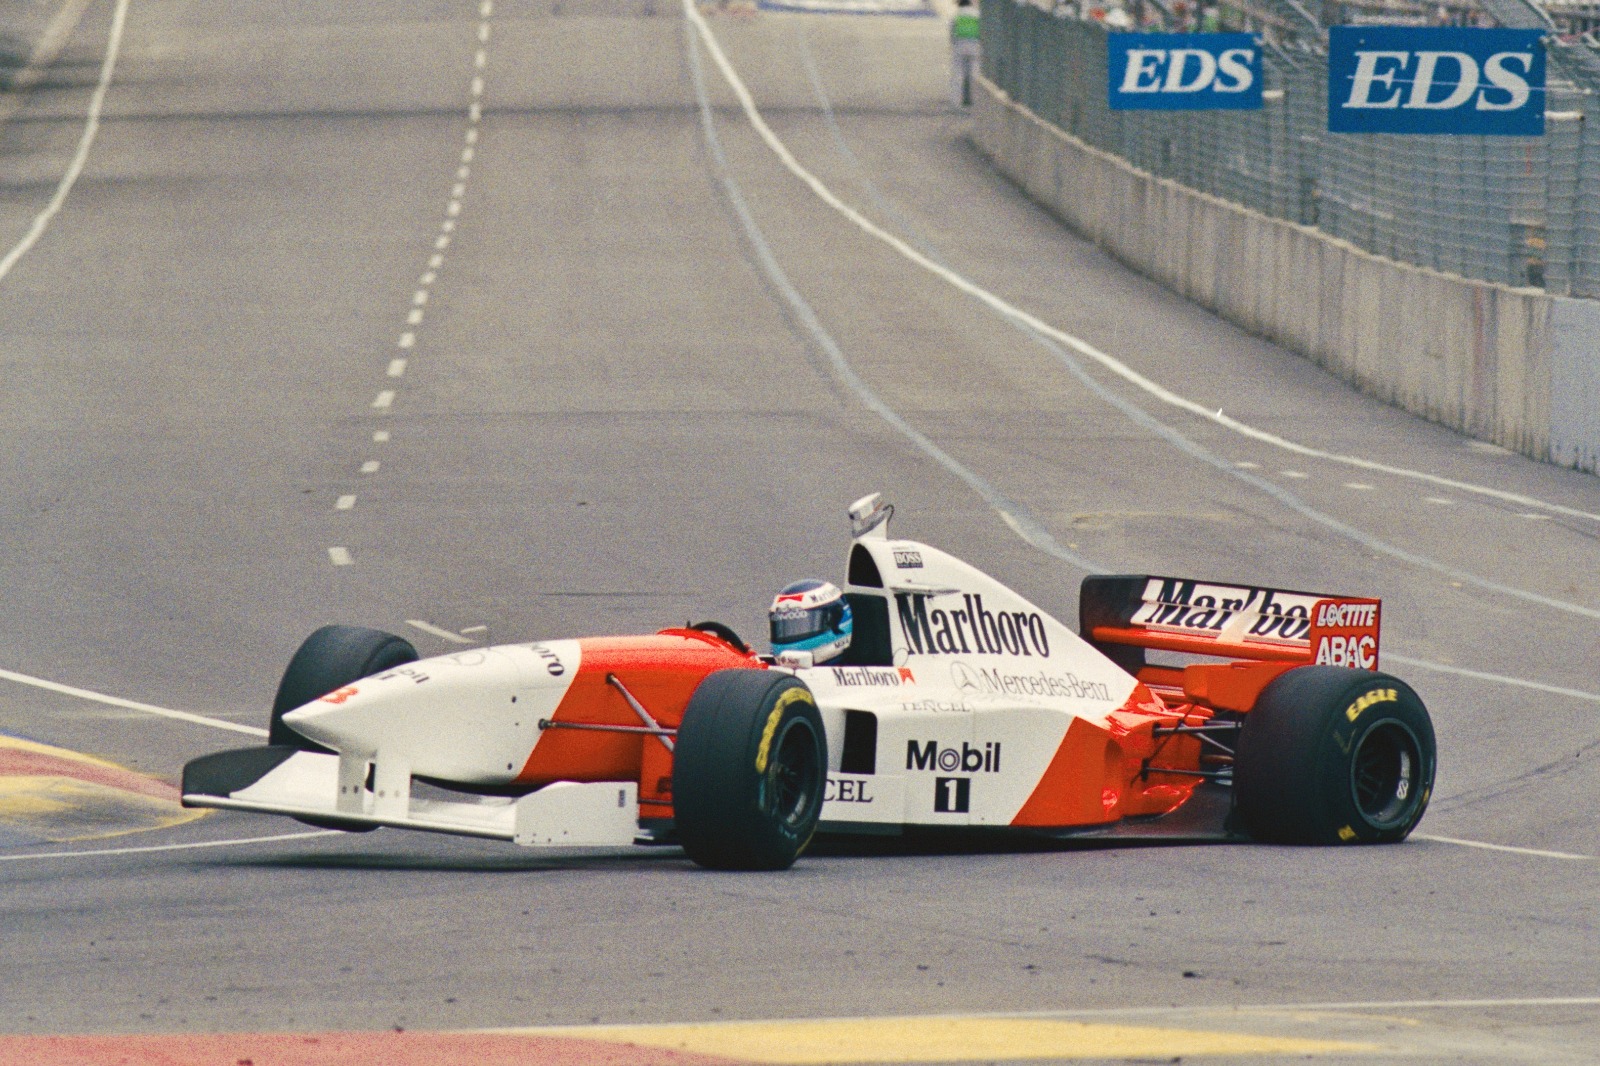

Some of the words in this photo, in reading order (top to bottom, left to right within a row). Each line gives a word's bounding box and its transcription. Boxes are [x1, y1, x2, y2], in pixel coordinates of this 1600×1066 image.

[1118, 48, 1255, 94] EDS
[1341, 50, 1534, 111] EDS
[894, 593, 1050, 659] Marlboro
[1316, 603, 1377, 627] LOCTITE
[1315, 635, 1376, 669] ABAC
[831, 667, 899, 687] Marlboro
[980, 668, 1114, 702] Mercedes-Benz
[1346, 689, 1398, 722] EAGLE
[905, 739, 1001, 773] Mobil
[944, 778, 958, 812] 1
